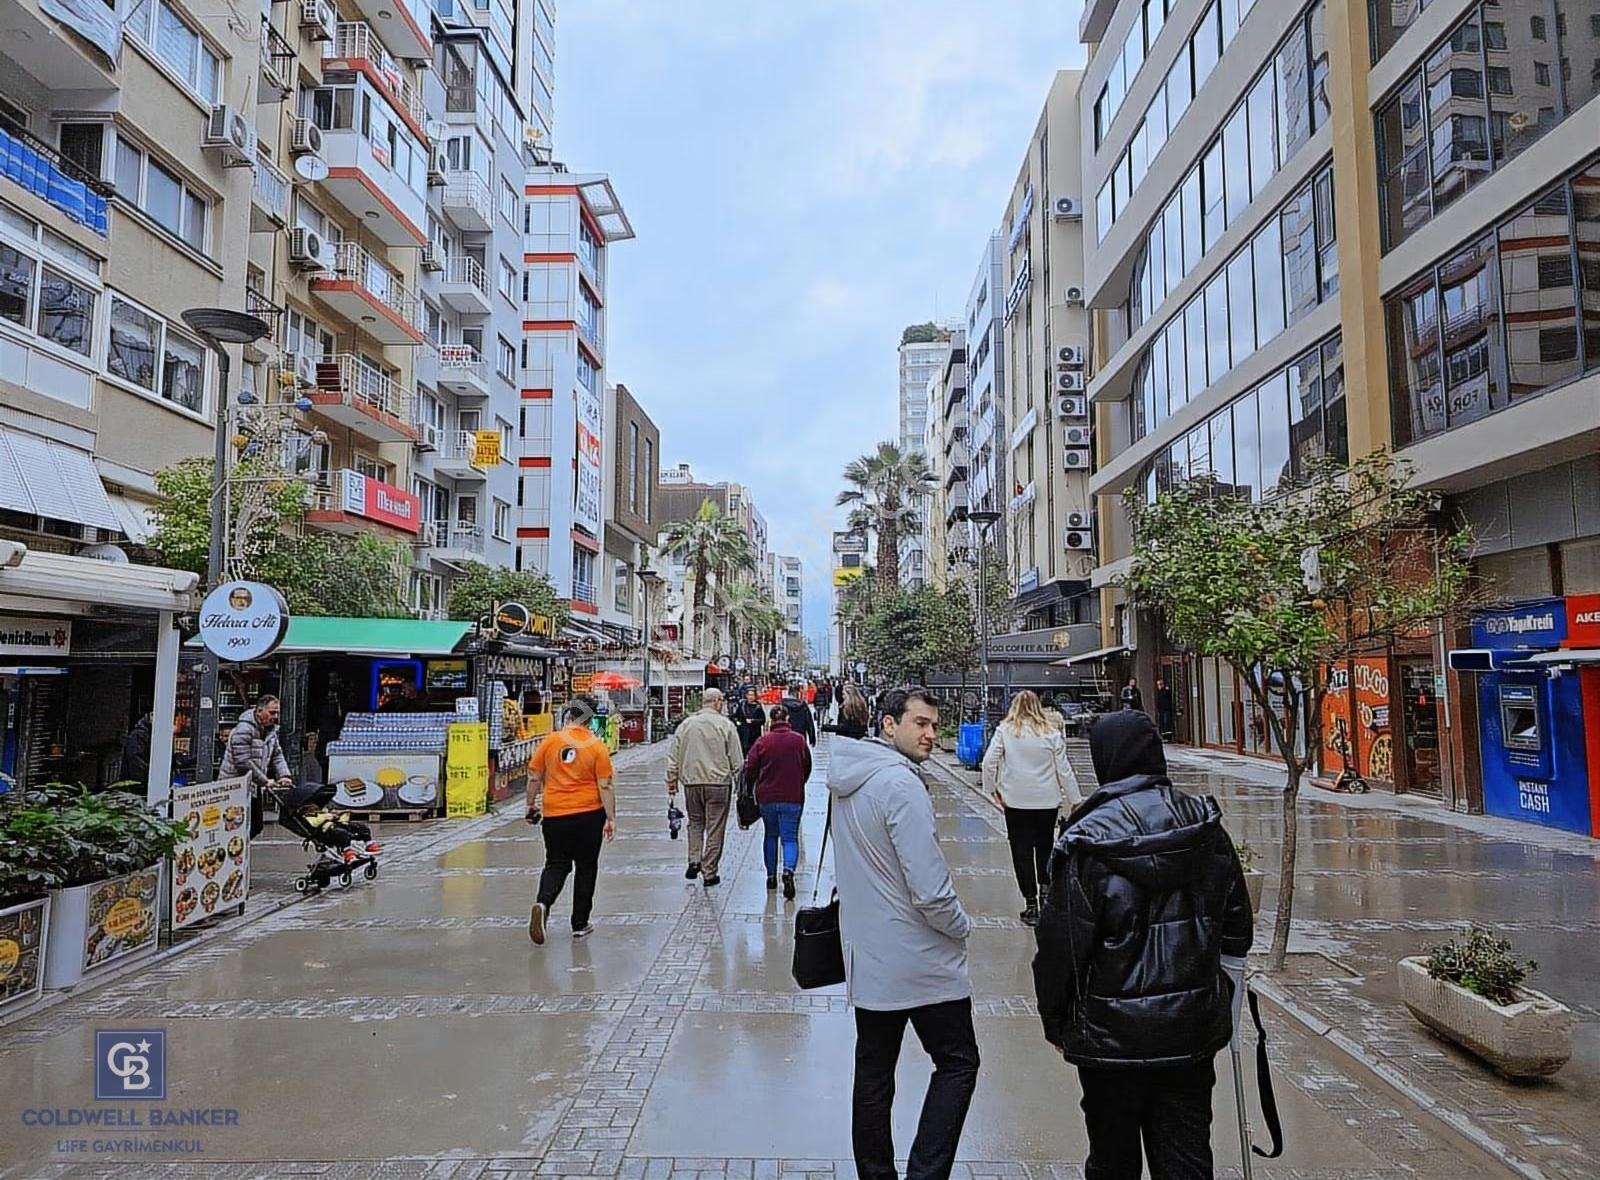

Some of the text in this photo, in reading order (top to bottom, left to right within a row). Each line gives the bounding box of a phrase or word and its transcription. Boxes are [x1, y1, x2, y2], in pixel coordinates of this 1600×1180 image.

[0, 630, 51, 646] enizBank
[1519, 780, 1547, 796] INSTANT
[1520, 792, 1550, 813] CASH
